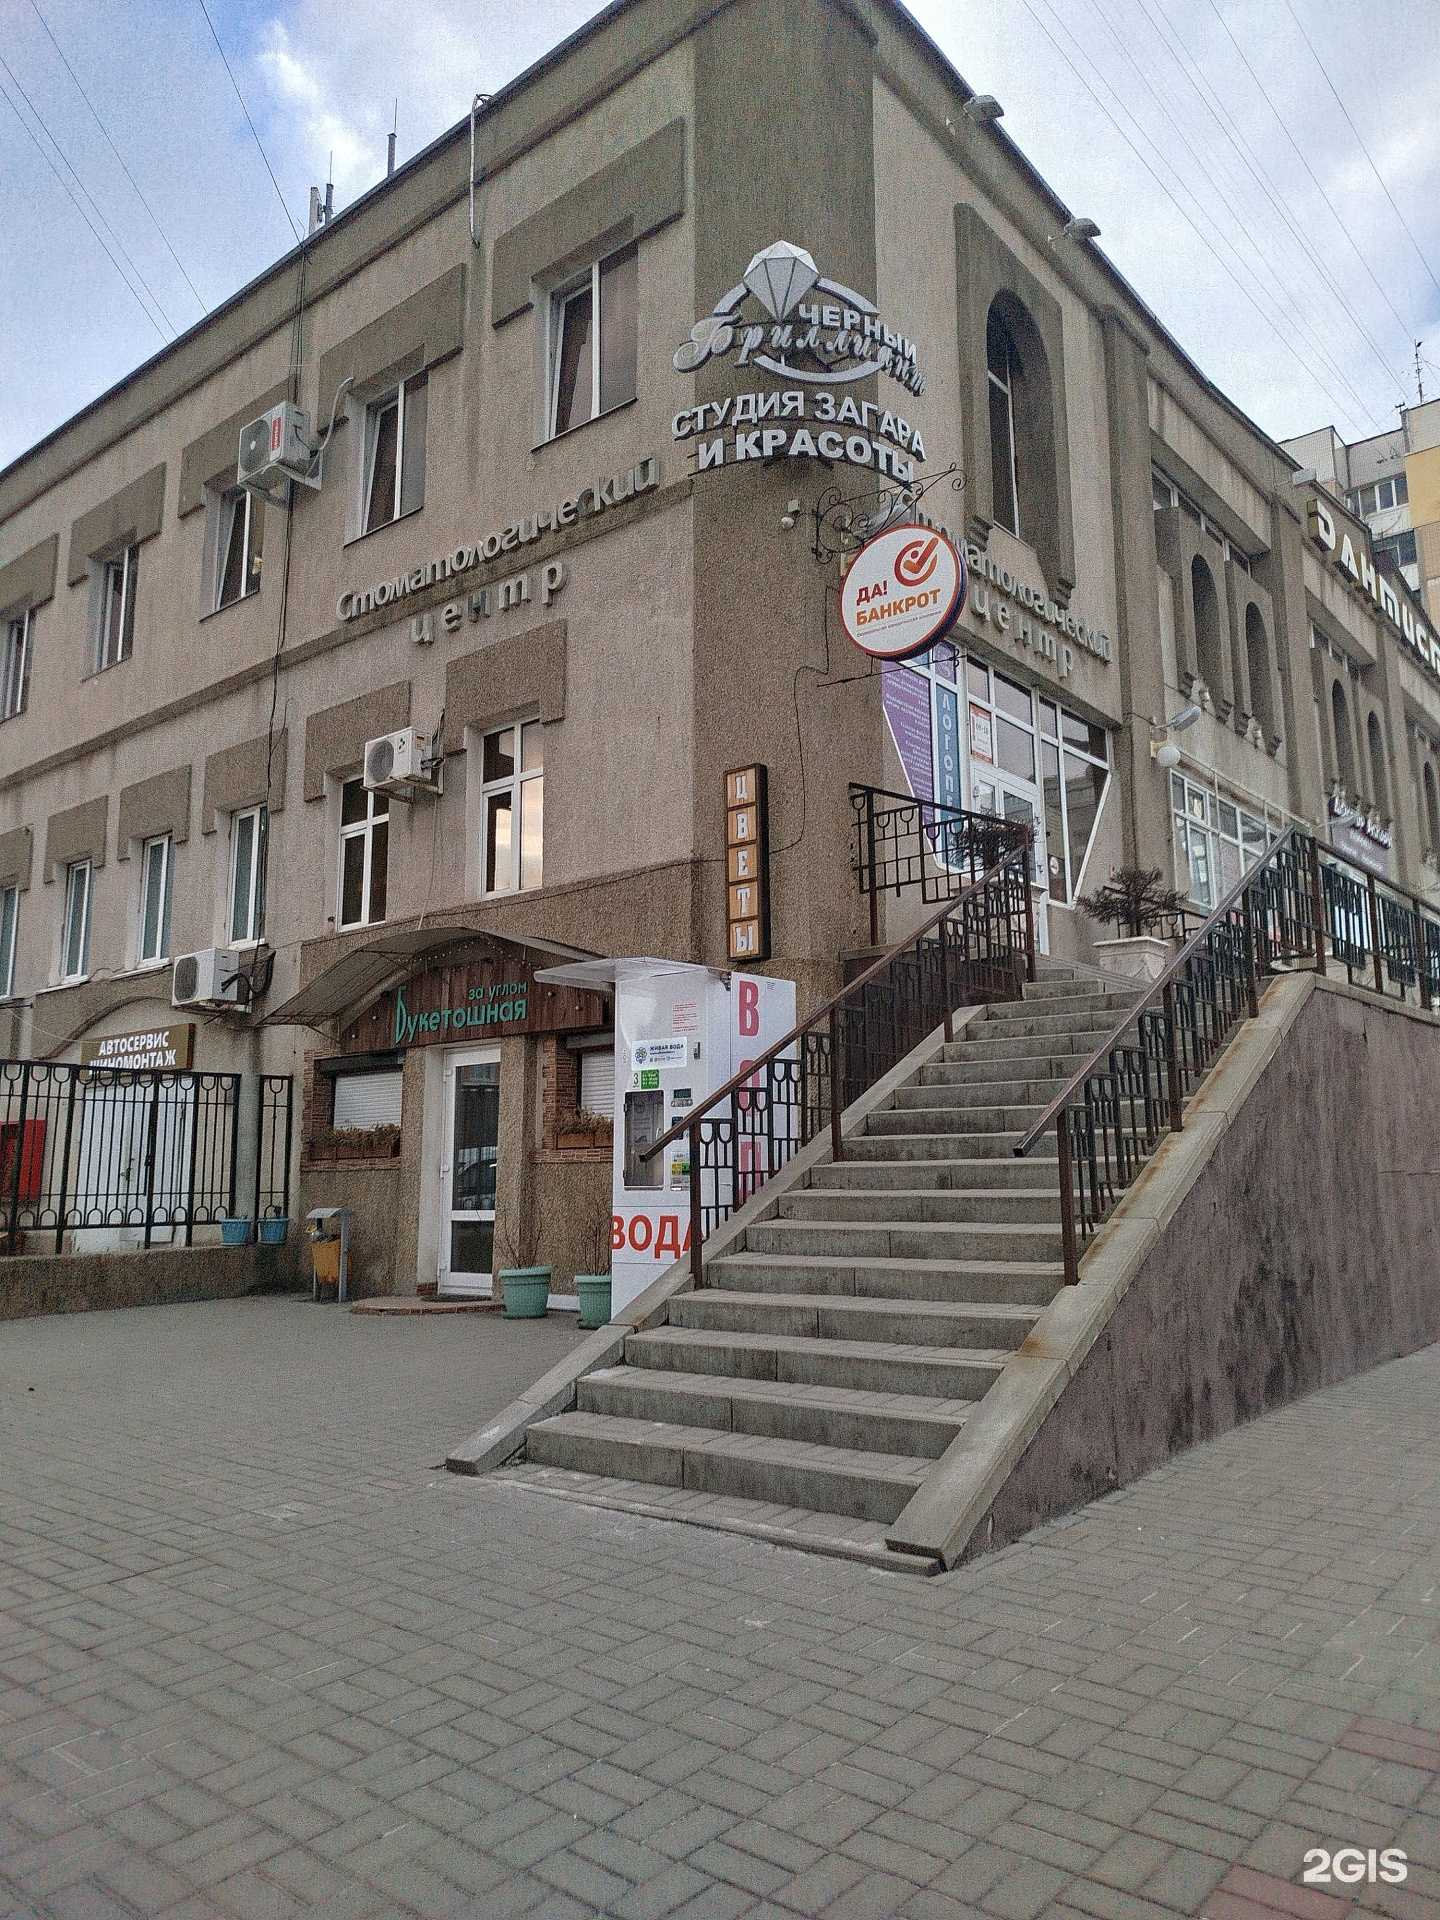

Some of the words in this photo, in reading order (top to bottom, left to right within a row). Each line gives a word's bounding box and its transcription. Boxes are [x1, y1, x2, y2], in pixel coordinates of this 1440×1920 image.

[671, 391, 804, 438] СТУДИЯ
[814, 392, 927, 461] ЗАГАРА
[698, 438, 724, 470] И
[735, 429, 914, 483] КРАСОТЫ
[856, 580, 888, 606] ДА!
[856, 588, 941, 626] БАНКРОТ
[734, 774, 753, 951] ЦВЕТЫ
[468, 987, 484, 1000] за
[488, 981, 528, 1001] углом
[395, 985, 528, 1044] Букетошная
[98, 1030, 170, 1056] АВТОСЕРВИС
